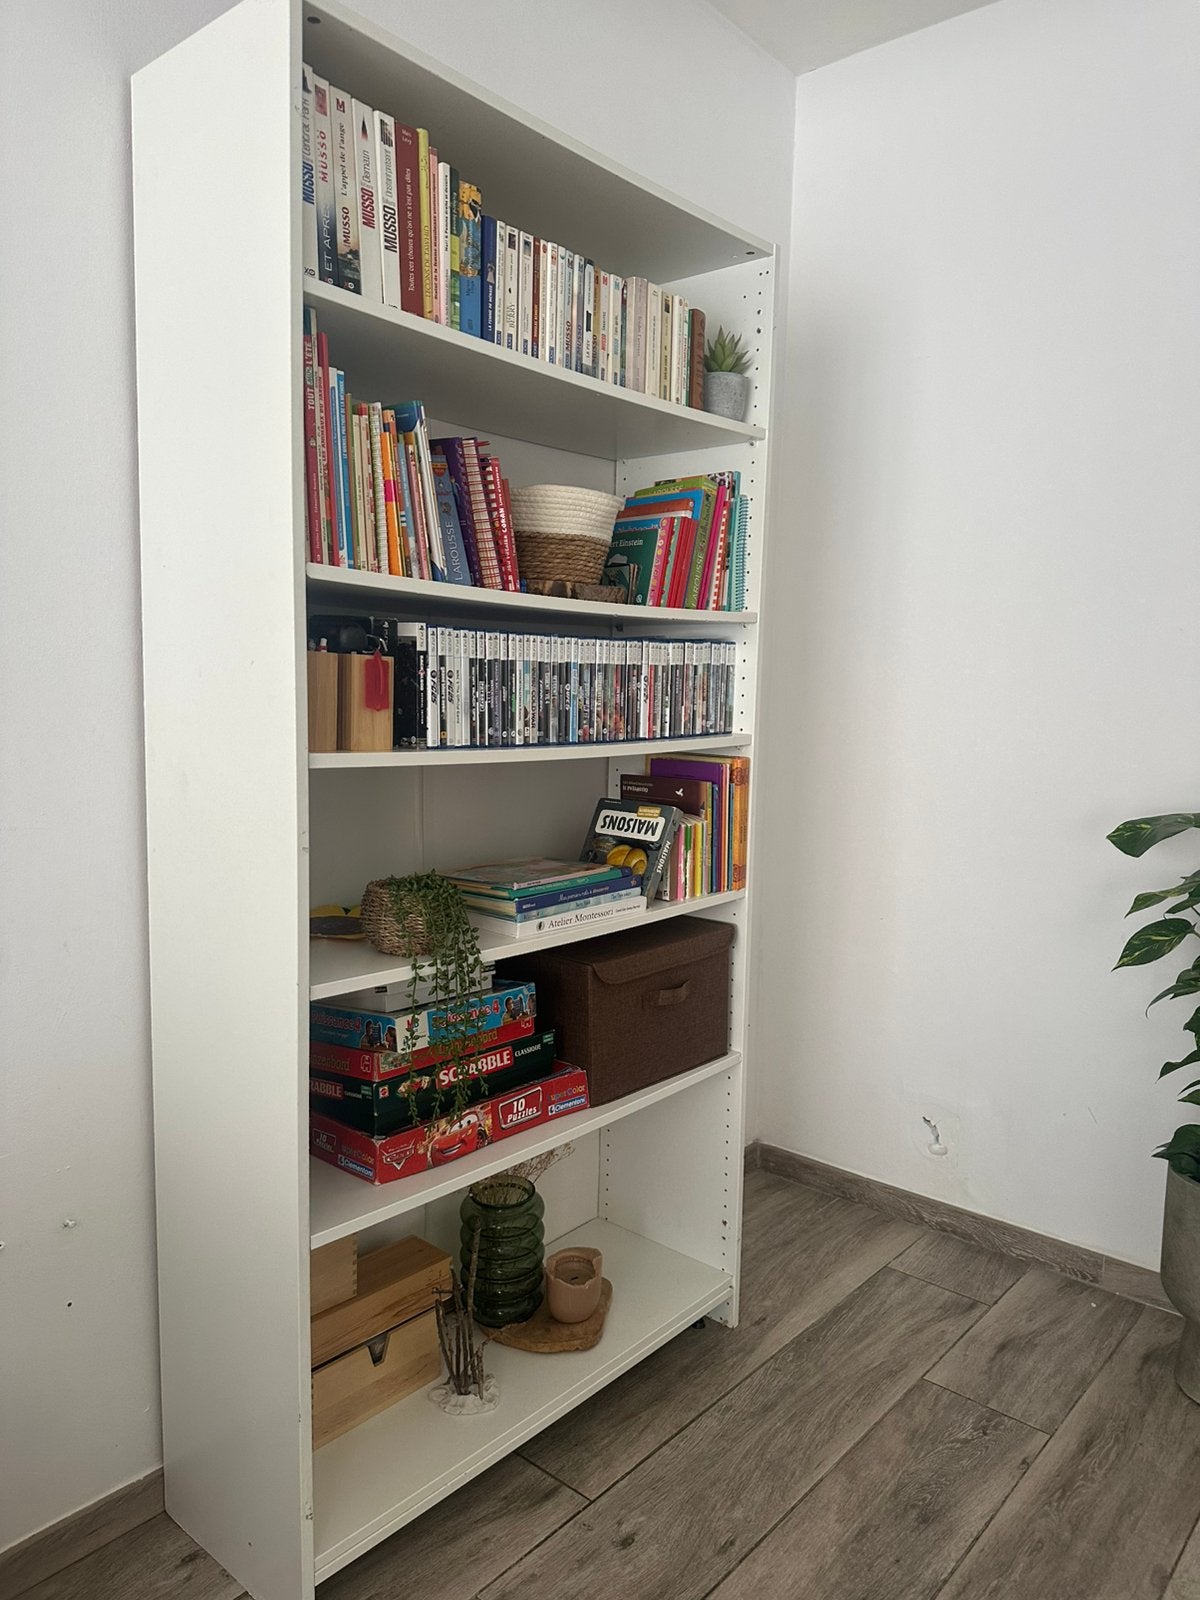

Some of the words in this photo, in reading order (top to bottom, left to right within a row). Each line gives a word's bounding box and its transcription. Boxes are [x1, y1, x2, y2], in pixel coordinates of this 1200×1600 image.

[337, 121, 347, 149] l'ange
[319, 129, 329, 182] MUSSO
[339, 150, 346, 162] de
[361, 150, 371, 183] Demain
[338, 164, 349, 195] L'appel
[361, 187, 376, 229] MUSSO
[406, 211, 412, 220] ne
[342, 205, 351, 244] MUSSO
[383, 204, 398, 253] MUSSO
[406, 221, 415, 237] qu'on
[406, 238, 414, 260] choses
[323, 250, 333, 272] ET
[407, 272, 415, 292] Toutes
[307, 387, 315, 410] TOUT
[318, 415, 326, 449] ANIMAUX
[498, 507, 507, 533] CORAN
[445, 520, 463, 580] LAROUSSE
[620, 539, 644, 547] Einstein
[691, 552, 705, 608] LAROUSSE
[600, 814, 660, 837] MAISONS
[656, 840, 671, 874] MAISONS
[548, 917, 573, 929] Atelier
[574, 909, 614, 923] Montessori
[491, 998, 501, 1014] 4
[515, 1043, 542, 1057] CLASSIQUE
[507, 1106, 537, 1123] Puzzles
[512, 1098, 526, 1114] 10
[555, 1097, 587, 1113] Clementoni
